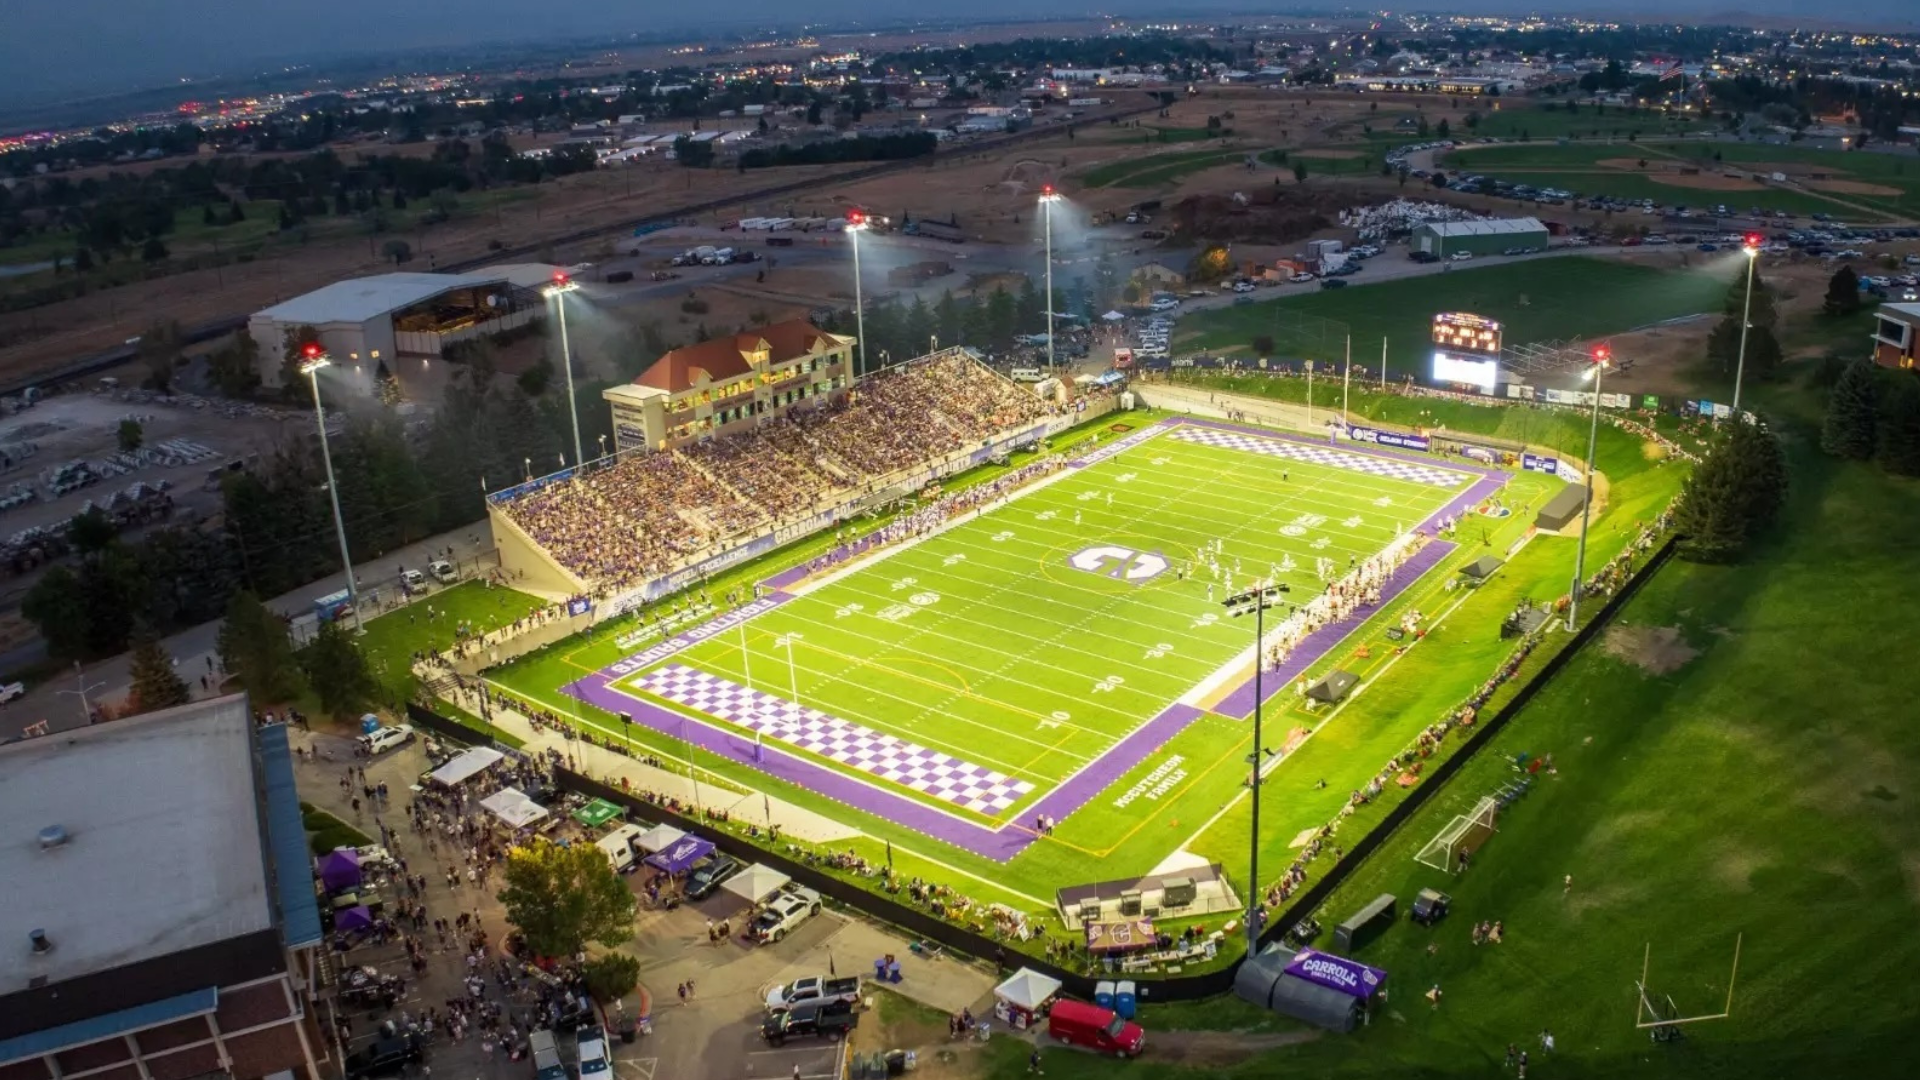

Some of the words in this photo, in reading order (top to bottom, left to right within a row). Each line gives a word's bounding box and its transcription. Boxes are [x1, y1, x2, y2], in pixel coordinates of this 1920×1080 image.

[687, 598, 778, 639] FIGHTING
[611, 638, 689, 674] SAINTS
[1095, 675, 1125, 692] 20
[1041, 711, 1071, 729] 10
[1145, 768, 1188, 800] FAMILY
[1303, 960, 1358, 986] CARROLL
